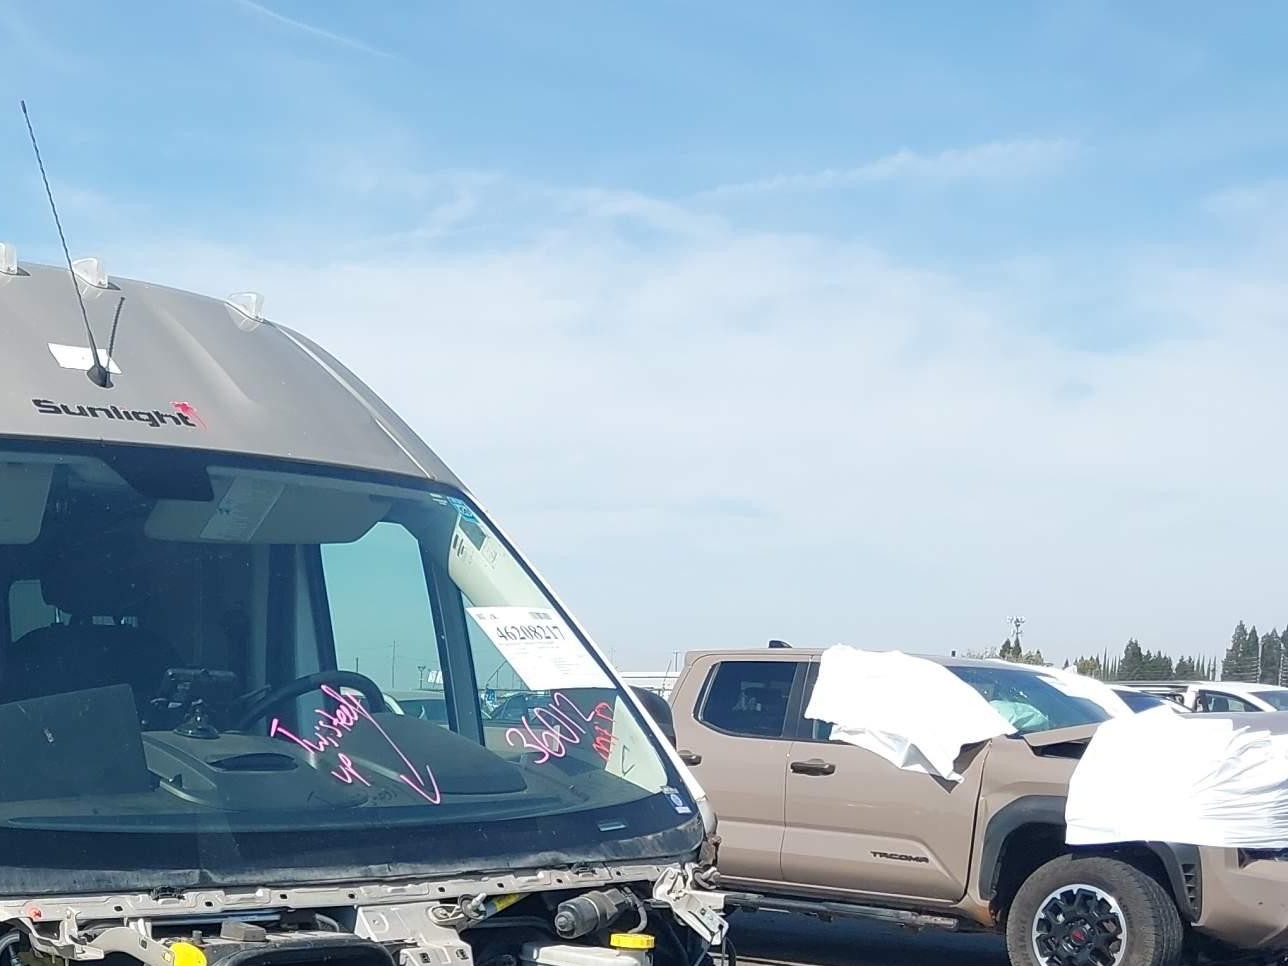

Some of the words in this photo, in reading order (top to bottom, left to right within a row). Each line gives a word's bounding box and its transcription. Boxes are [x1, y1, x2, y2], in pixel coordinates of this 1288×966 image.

[31, 398, 197, 428] Sunlight
[495, 624, 567, 641] 46208217
[870, 850, 930, 864] TACOMA
